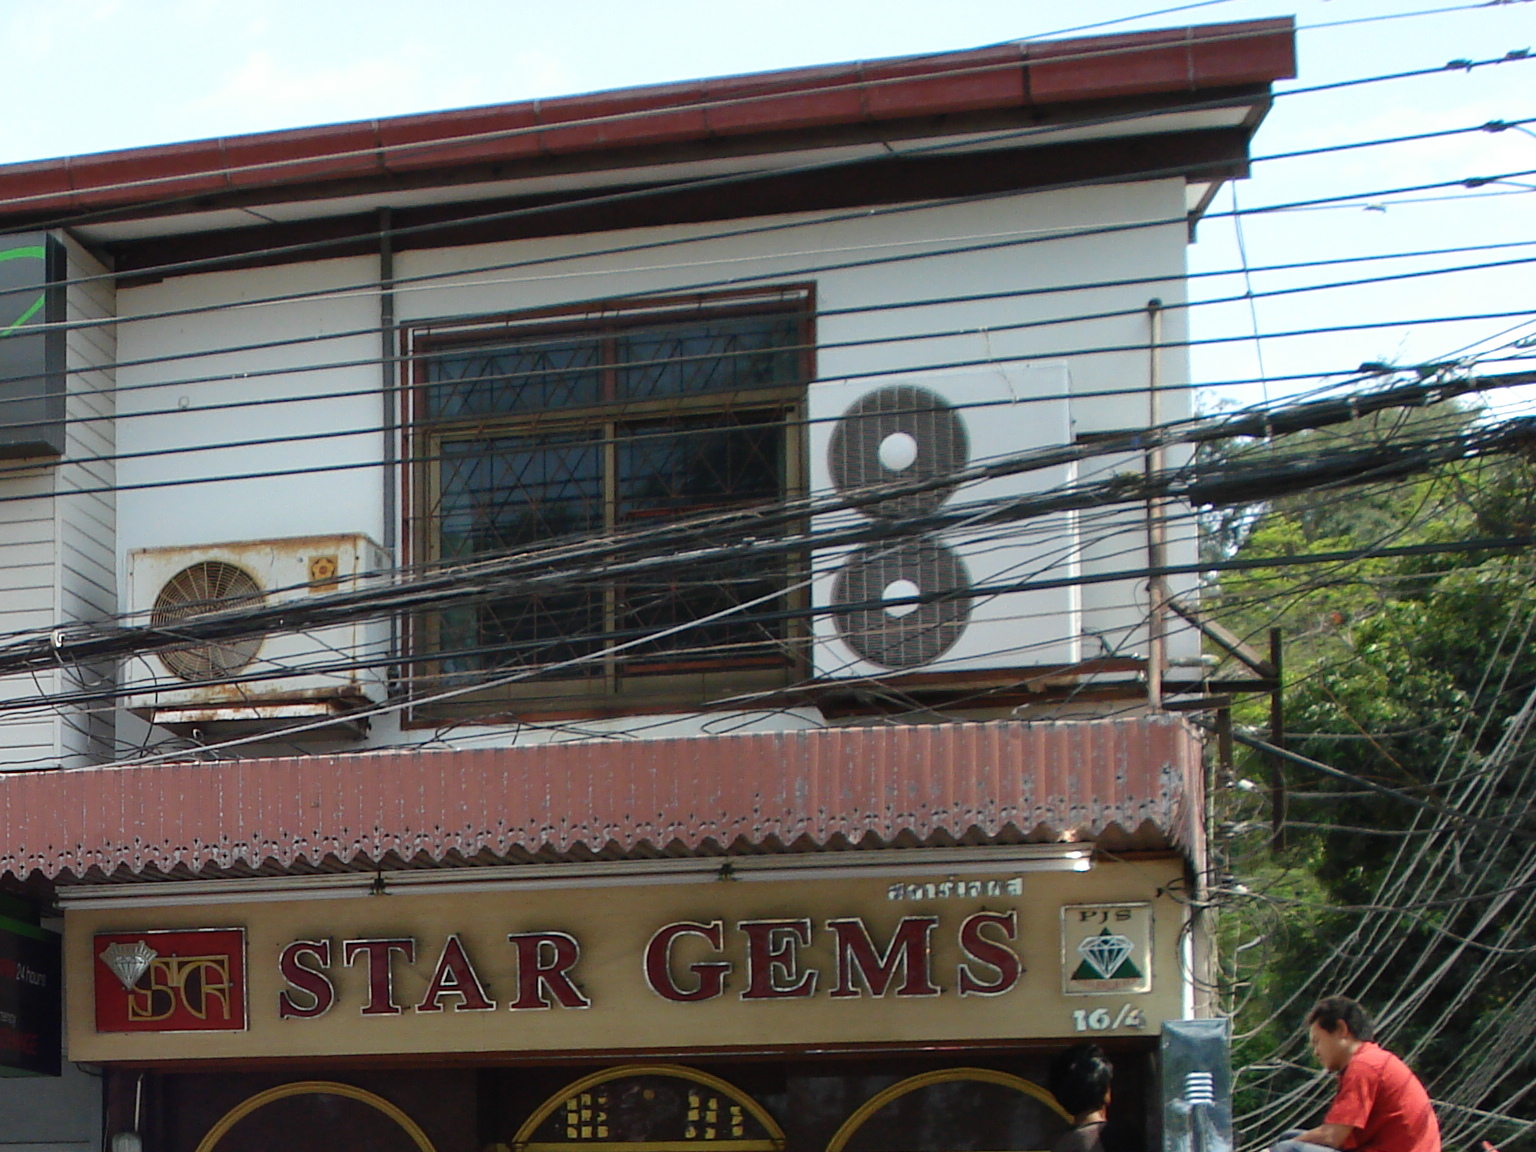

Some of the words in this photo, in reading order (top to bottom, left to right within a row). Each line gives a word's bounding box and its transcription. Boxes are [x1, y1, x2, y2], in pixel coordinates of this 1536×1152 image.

[1079, 909, 1132, 924] PJS
[277, 930, 592, 1020] STAR
[643, 909, 1024, 1001] GEMS
[1073, 1003, 1146, 1032] 16/4
